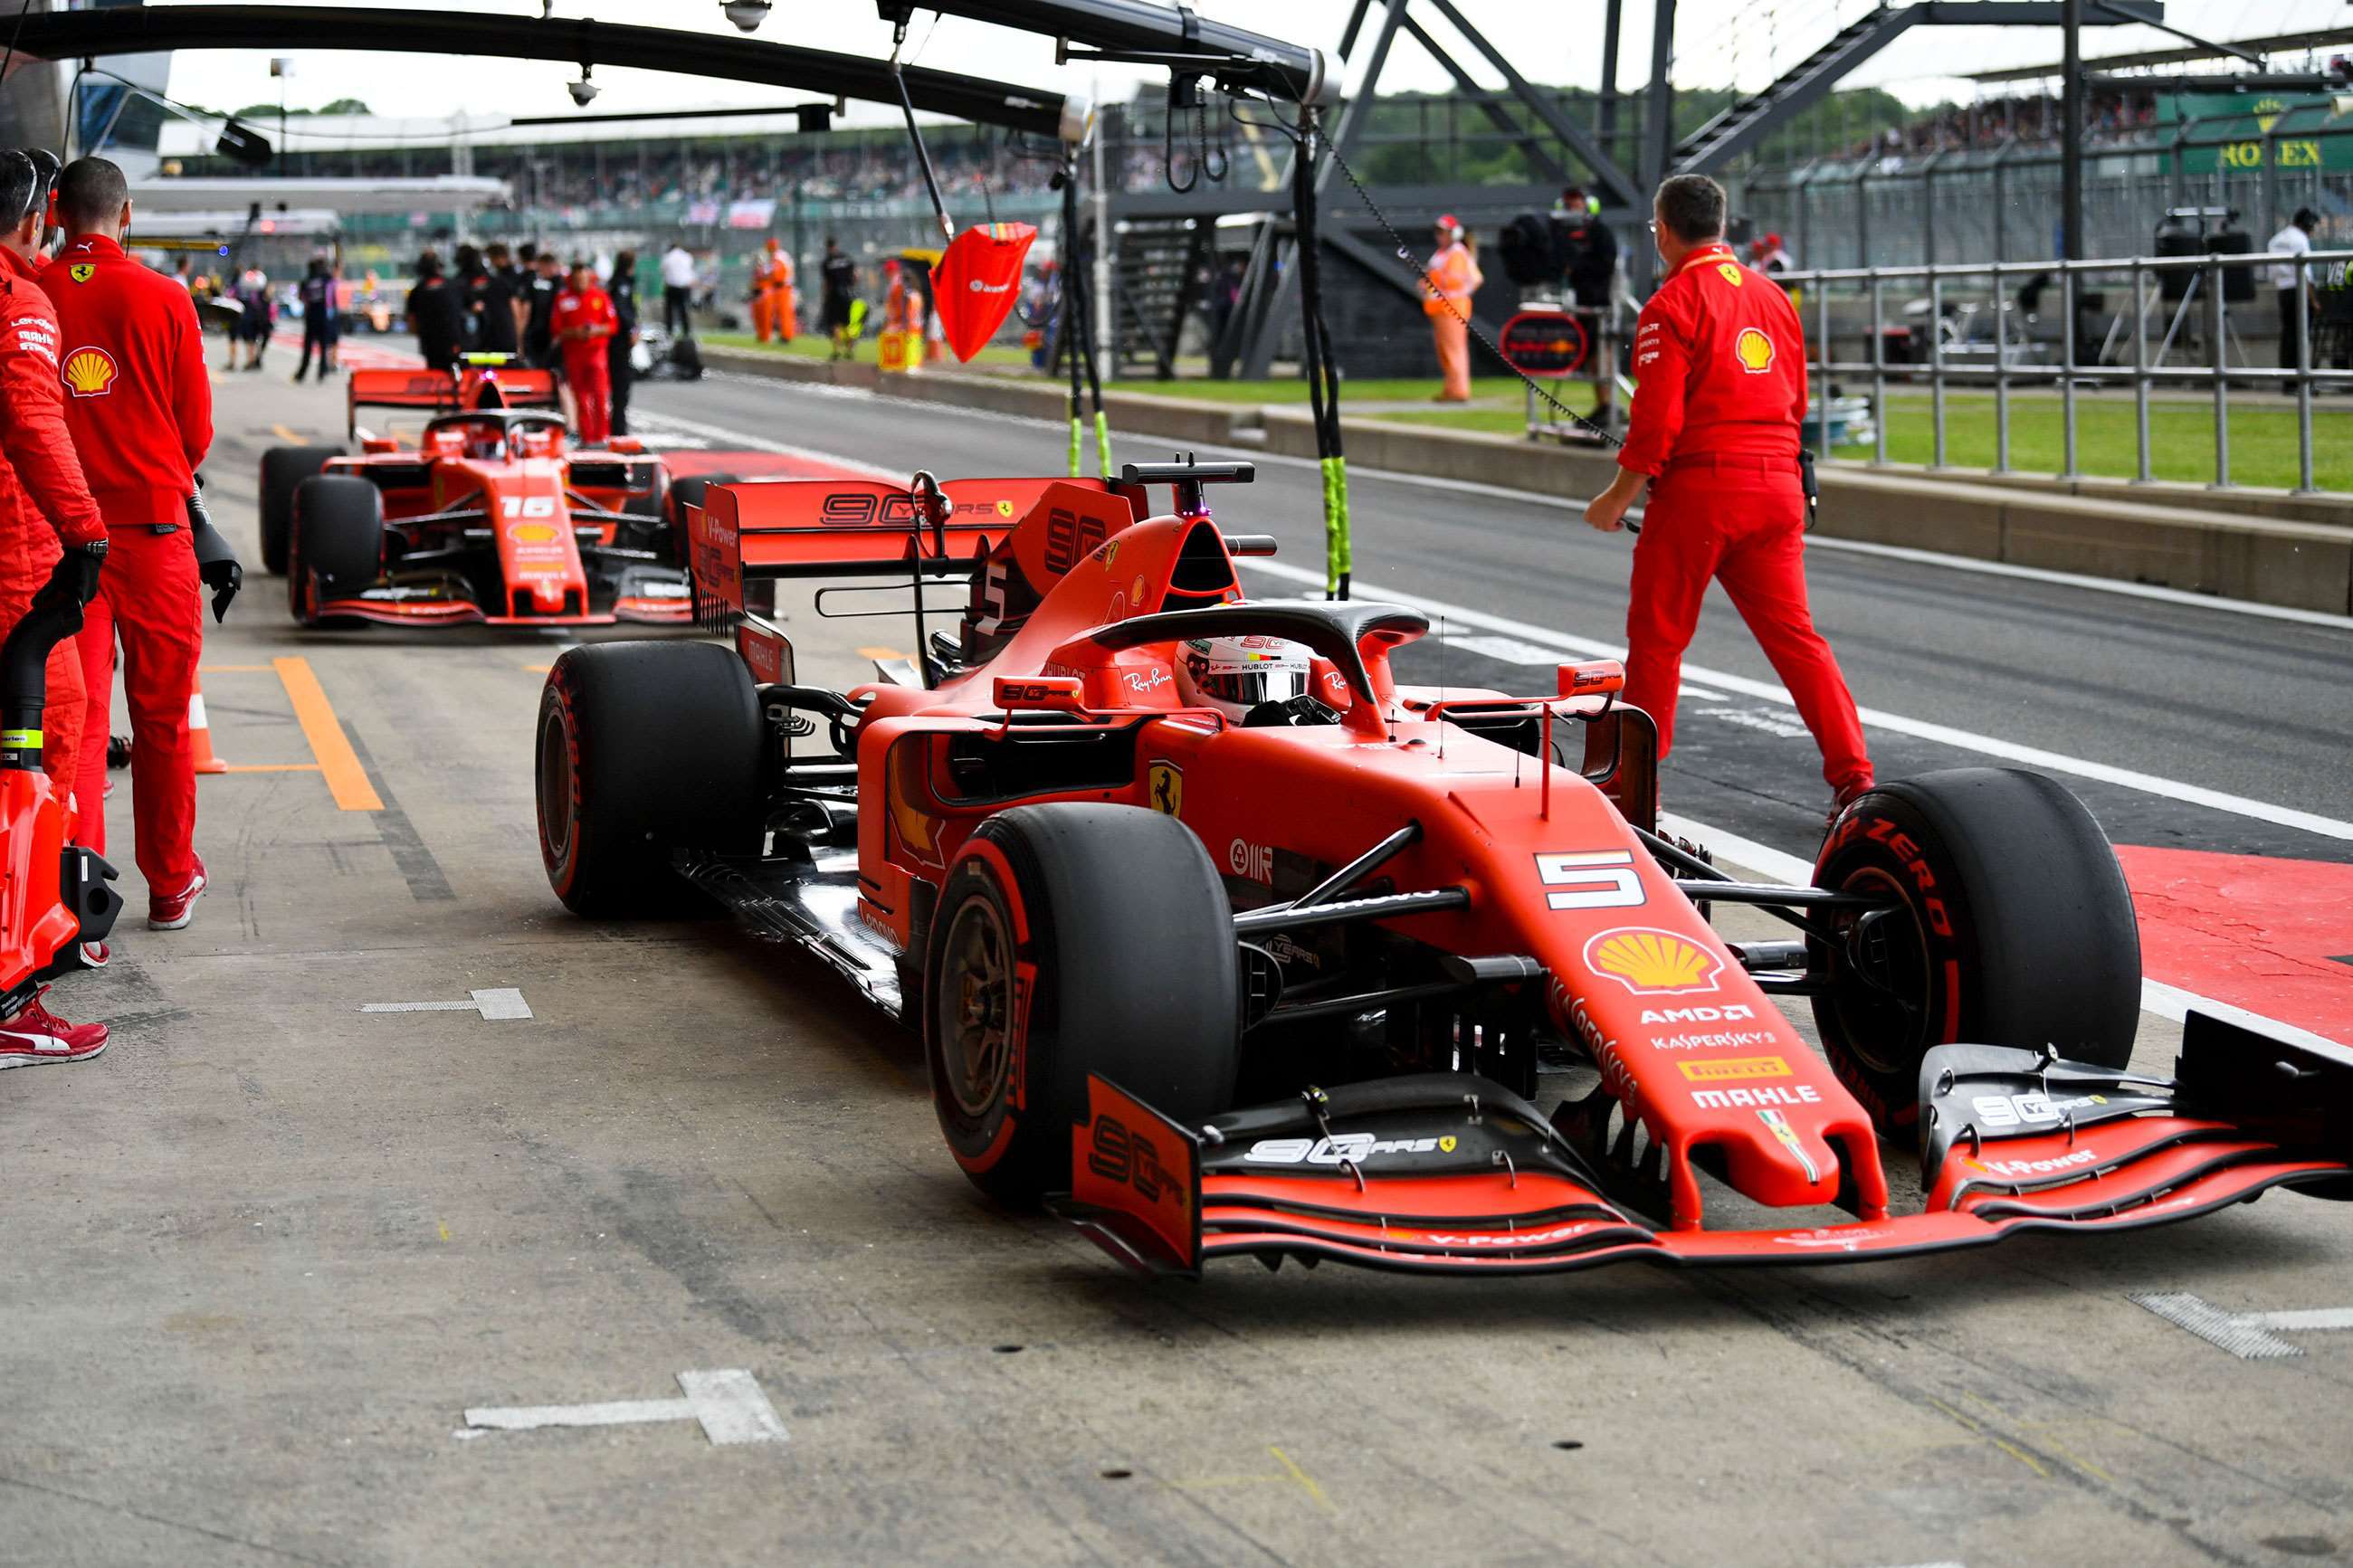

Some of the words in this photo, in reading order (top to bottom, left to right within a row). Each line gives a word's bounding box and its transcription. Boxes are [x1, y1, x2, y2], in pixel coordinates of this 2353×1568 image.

[2219, 141, 2321, 167] ROEX
[500, 496, 555, 518] 16
[707, 515, 738, 548] V-Power
[975, 558, 1007, 637] 5
[1533, 849, 1647, 910] 5
[1866, 816, 1954, 936] ZERO
[1640, 1004, 1720, 1024] AMD
[1650, 1031, 1763, 1050] KASPERSKY
[1690, 1085, 1823, 1109] MAHLE
[1243, 1133, 1377, 1164] 90
[1982, 1148, 2098, 1177] V-Power
[1427, 1223, 1589, 1245] V-Power
